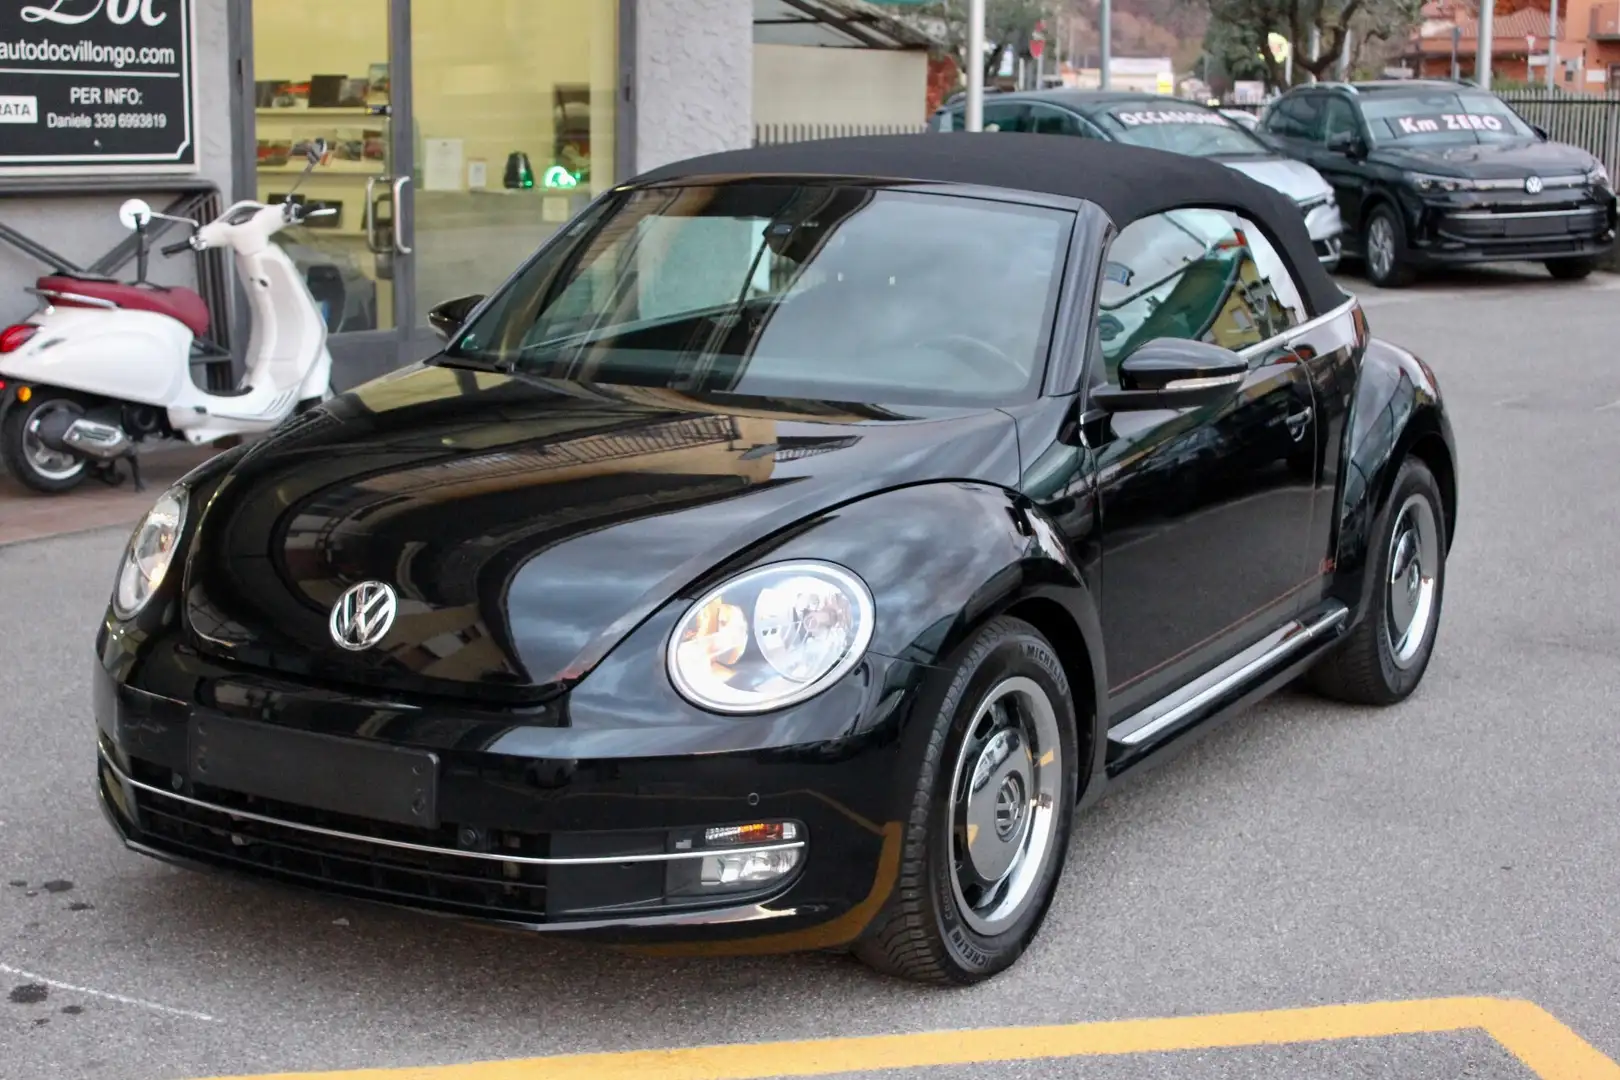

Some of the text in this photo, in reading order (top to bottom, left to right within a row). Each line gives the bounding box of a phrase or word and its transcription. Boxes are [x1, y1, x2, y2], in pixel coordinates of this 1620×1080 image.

[0, 38, 175, 68] autodocvillongo.com
[70, 87, 143, 105] PER INFO:
[0, 103, 31, 116] ATA
[47, 112, 92, 128] Daniele
[94, 112, 116, 128] 339
[1399, 113, 1502, 133] Km ZERO
